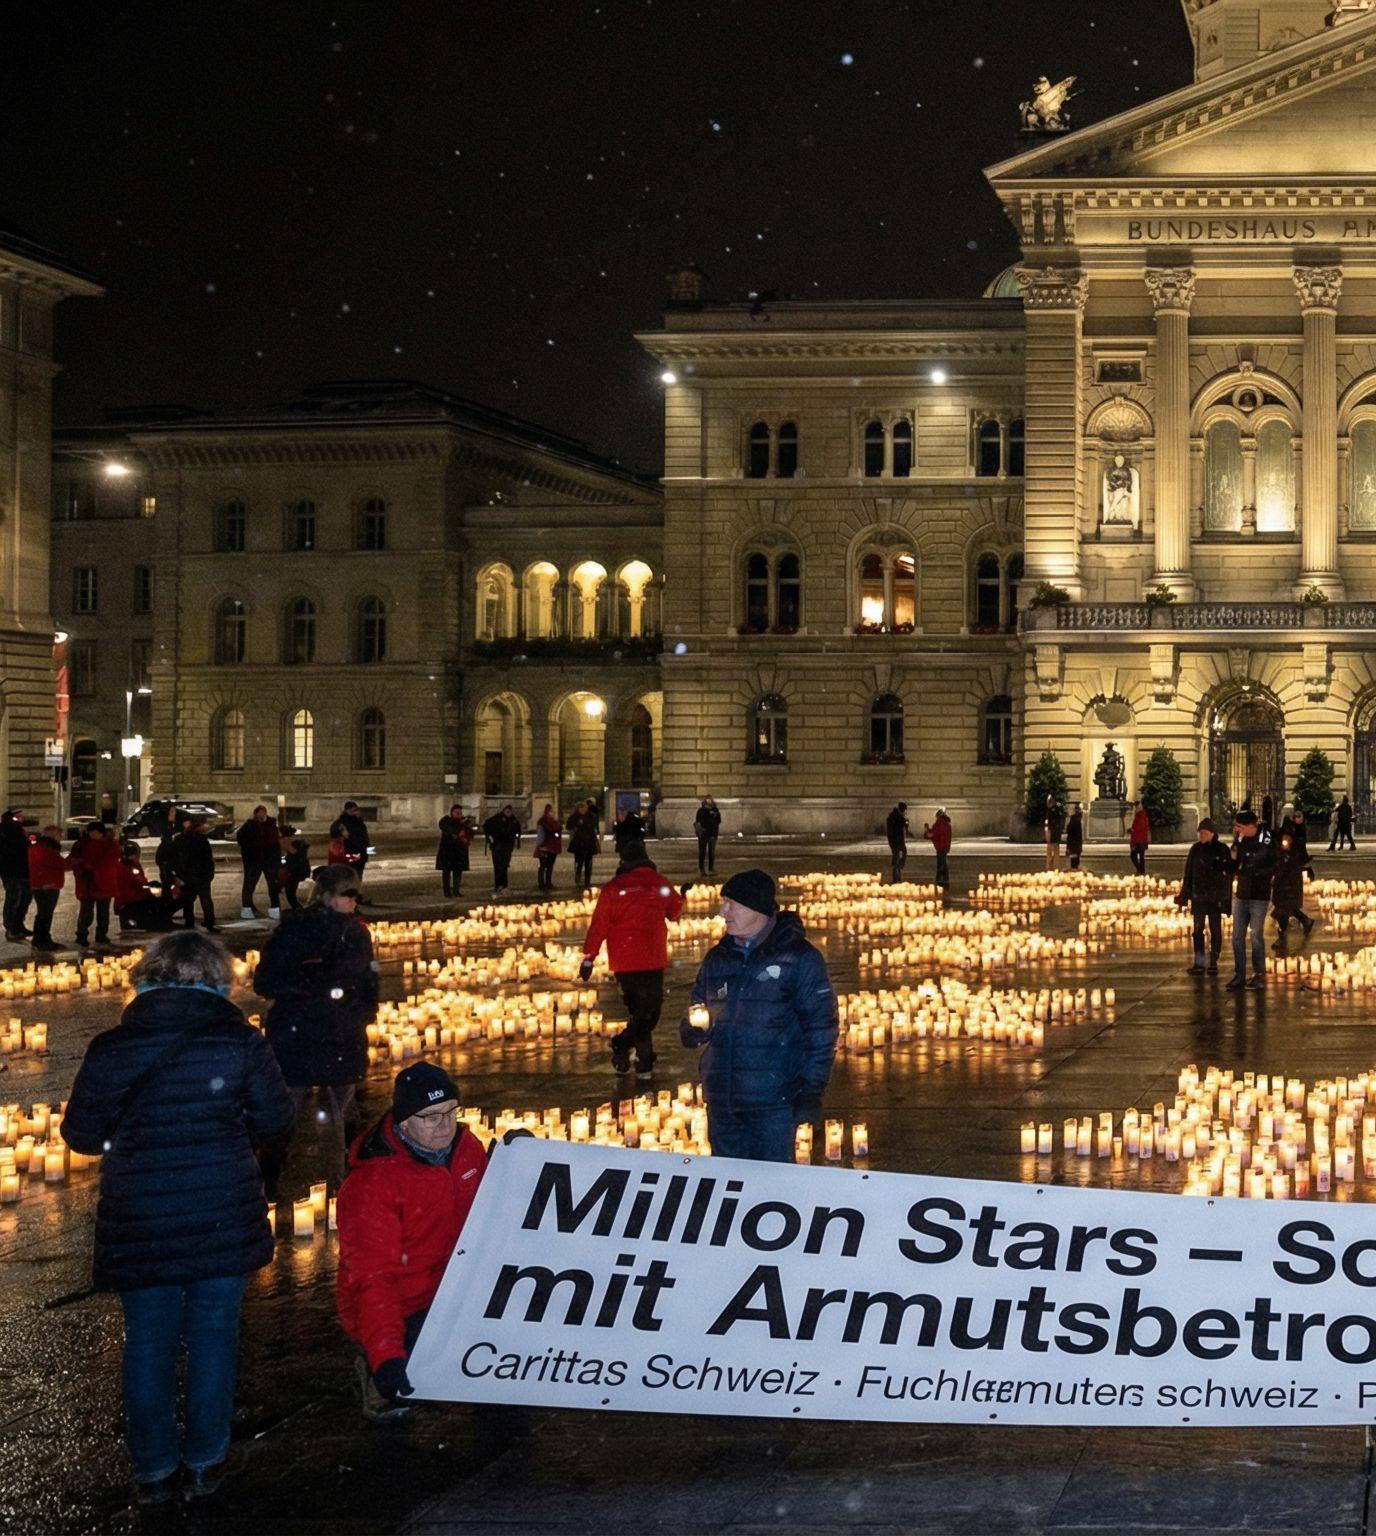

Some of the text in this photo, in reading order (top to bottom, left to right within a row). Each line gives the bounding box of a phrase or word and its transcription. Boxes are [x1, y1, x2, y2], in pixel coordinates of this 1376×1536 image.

[1128, 219, 1316, 240] BUNDESHAUS
[520, 1162, 865, 1258] Million
[899, 1197, 1158, 1277] Stars
[483, 1253, 677, 1332] mit
[461, 1341, 628, 1387] Carittas
[642, 1353, 820, 1396] Schweiz
[1157, 1378, 1319, 1408] schweiz
